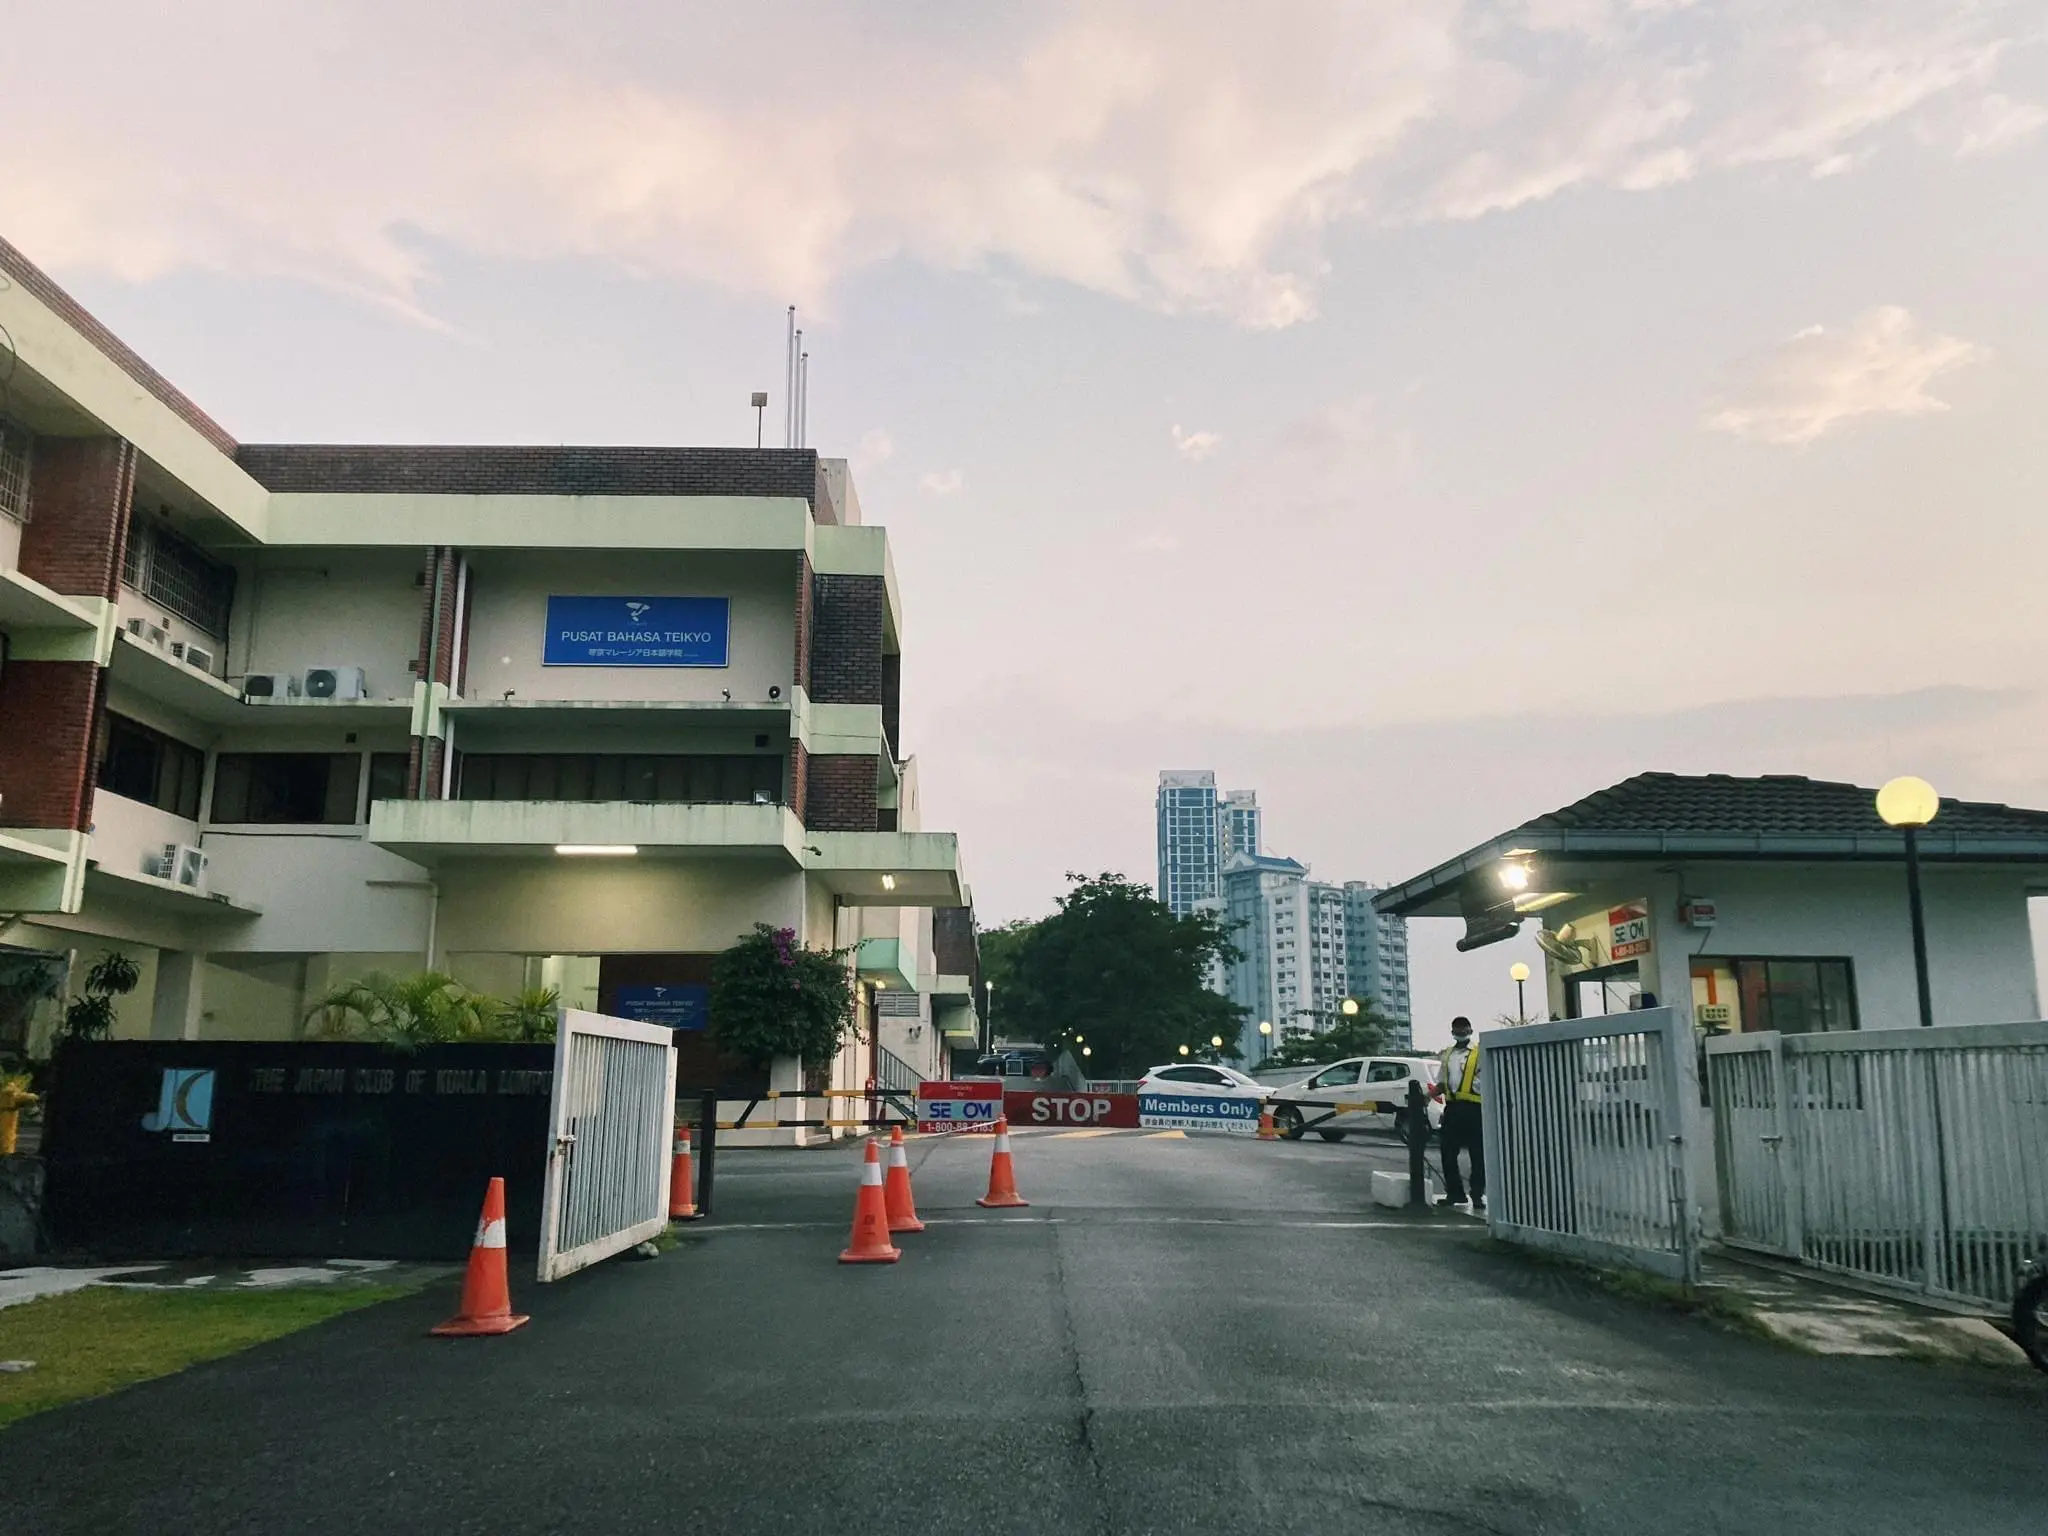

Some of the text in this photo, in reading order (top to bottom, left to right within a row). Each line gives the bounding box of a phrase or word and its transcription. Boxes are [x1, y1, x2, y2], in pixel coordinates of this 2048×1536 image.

[561, 631, 711, 643] PUSAT BAHASA TEIKYO
[1614, 919, 1645, 944] SEOM
[293, 1068, 346, 1094] JAPAN
[354, 1068, 395, 1095] CLUB
[405, 1069, 427, 1094] OF
[436, 1069, 487, 1095] KUALA
[497, 1069, 552, 1096] LUMPU
[929, 1102, 992, 1119] SEOM
[1031, 1097, 1112, 1122] STOP
[1145, 1098, 1253, 1119] Members Only
